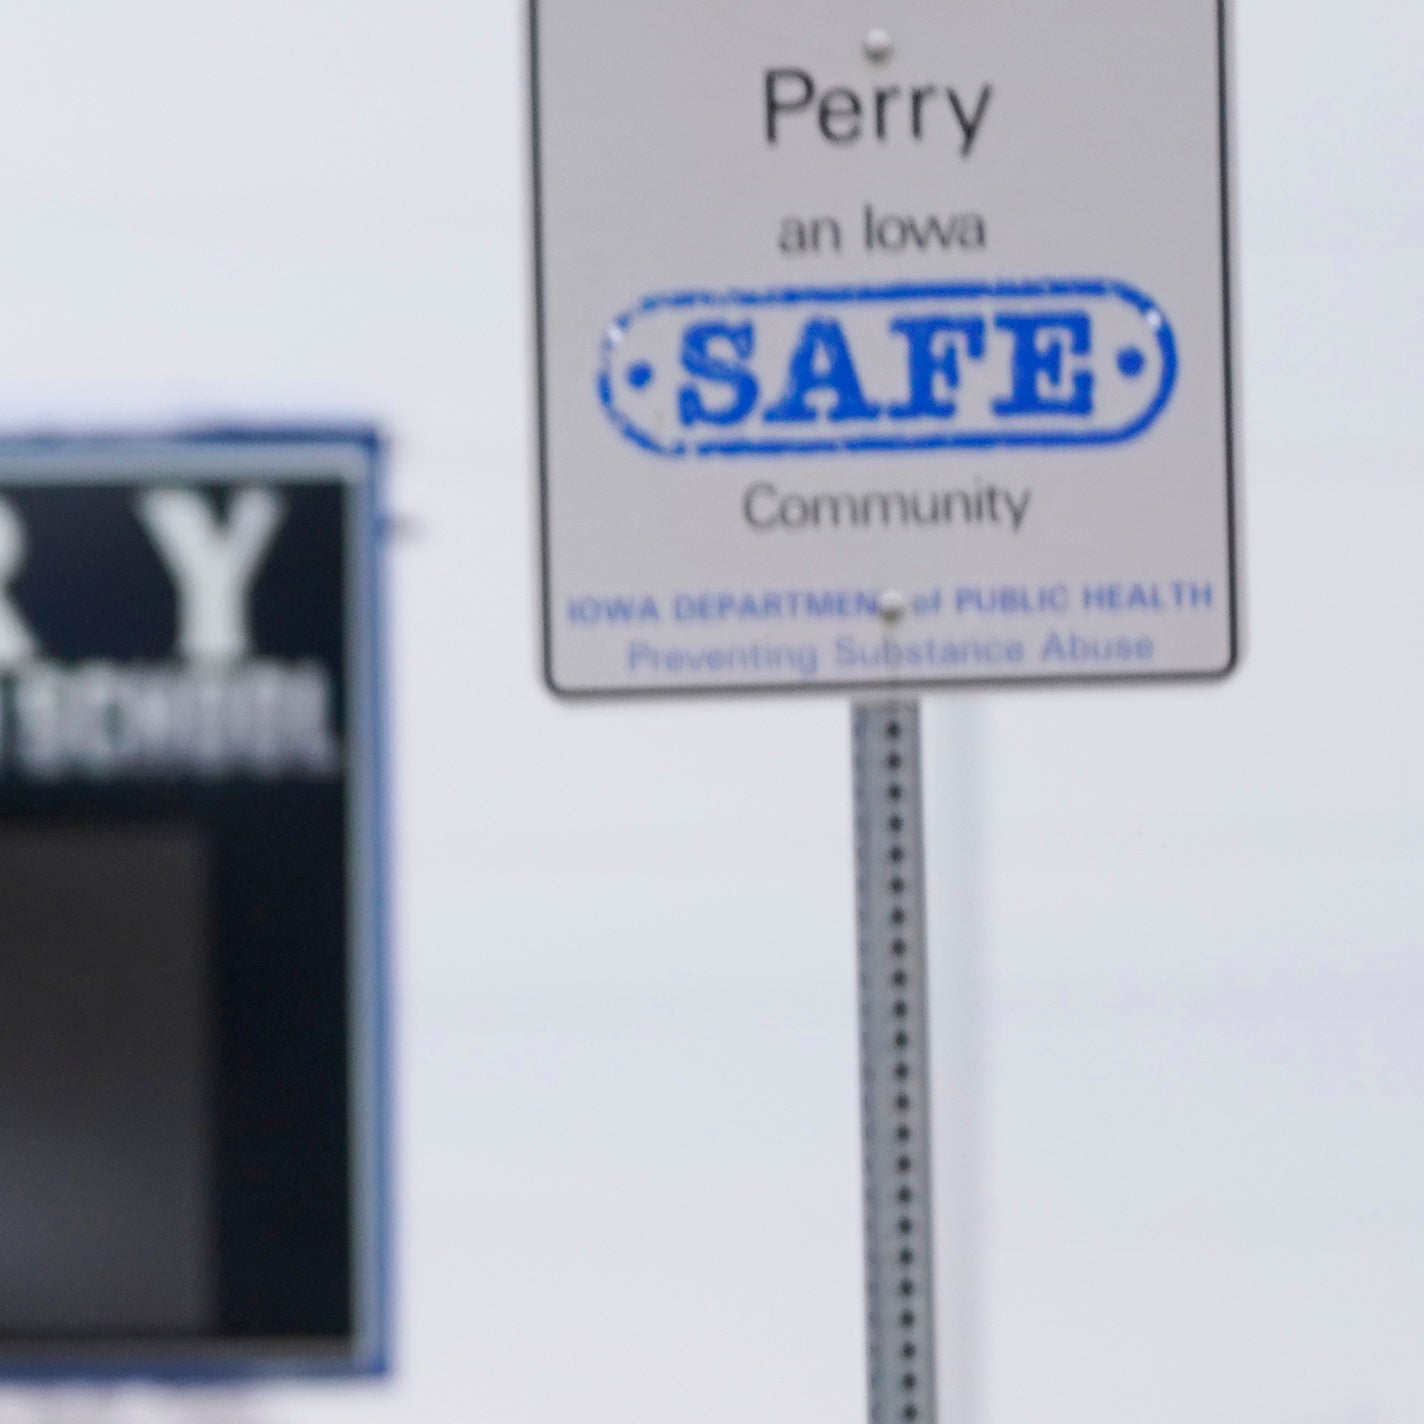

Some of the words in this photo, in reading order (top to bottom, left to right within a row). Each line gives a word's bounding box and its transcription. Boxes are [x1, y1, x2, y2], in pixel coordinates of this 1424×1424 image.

[761, 66, 992, 157] Perry
[777, 212, 843, 256] an
[863, 204, 988, 255] Iowa
[675, 310, 1096, 428] SAFE
[741, 478, 1031, 535] Community
[567, 598, 659, 626] IOWA
[673, 589, 898, 622] DEPARTMEN
[955, 584, 1069, 614] PUBLIC
[1082, 580, 1214, 611] HEALTH
[627, 639, 818, 675] Preventing
[834, 634, 1025, 666] Substance
[1041, 628, 1156, 662] Abuse
[16, 662, 340, 780] SCHOOL
